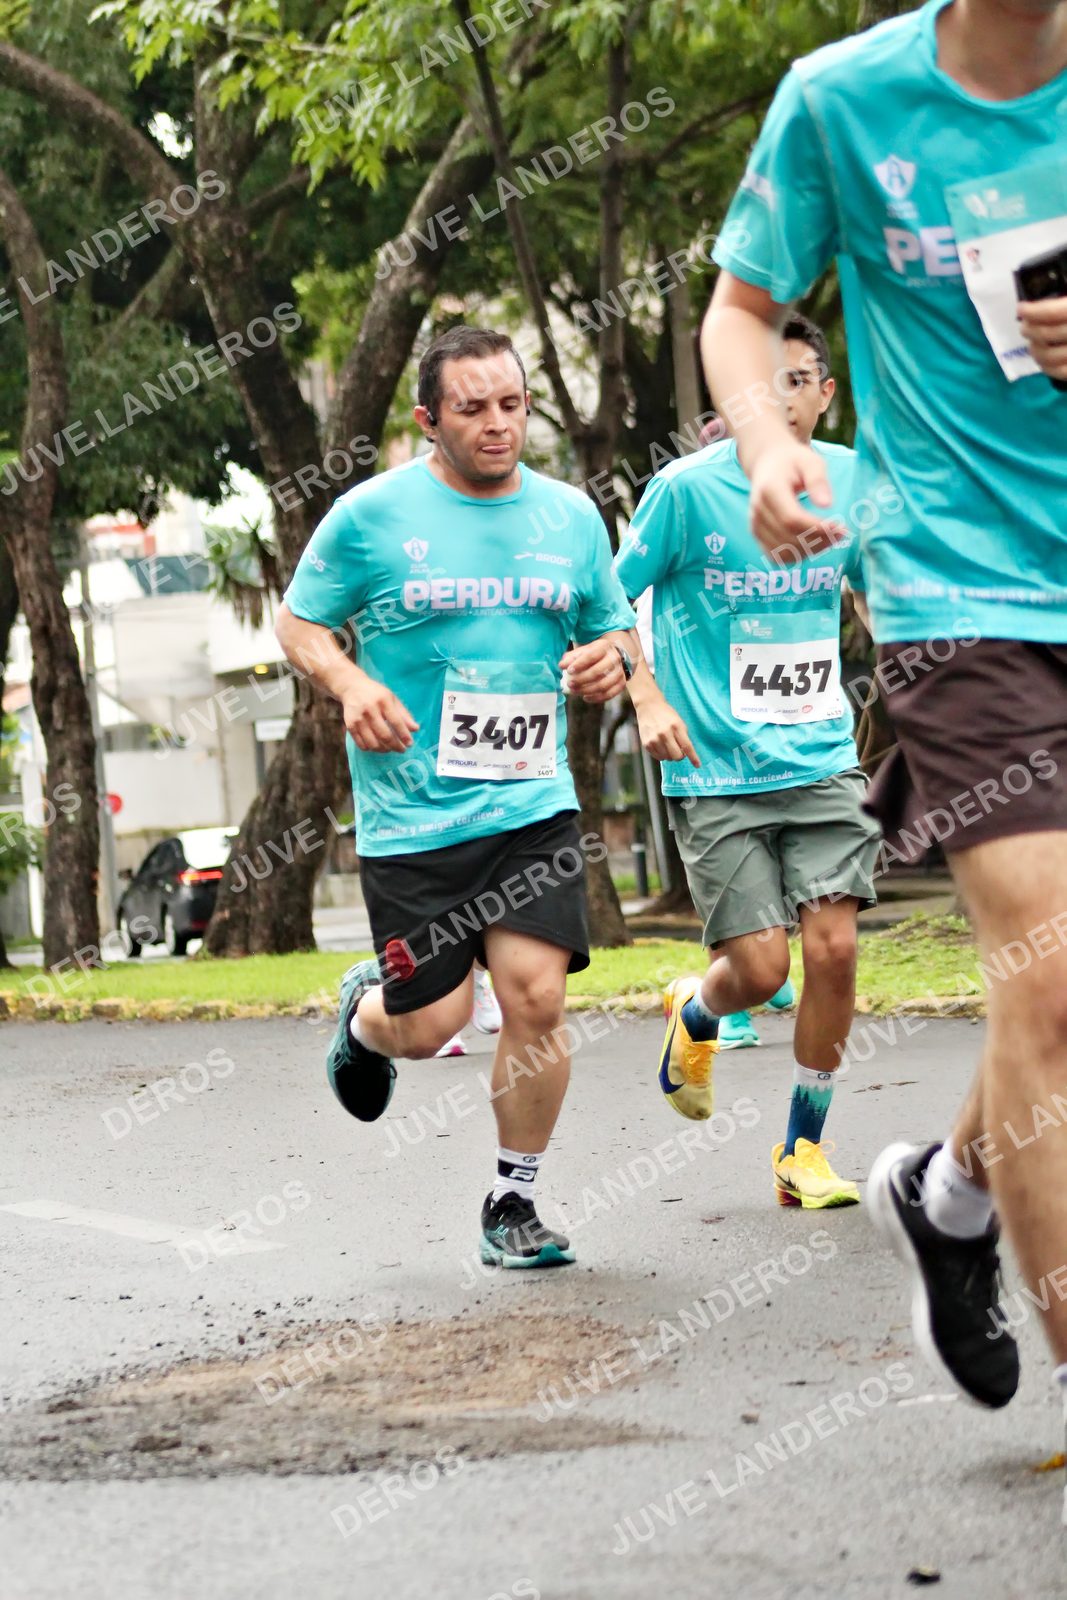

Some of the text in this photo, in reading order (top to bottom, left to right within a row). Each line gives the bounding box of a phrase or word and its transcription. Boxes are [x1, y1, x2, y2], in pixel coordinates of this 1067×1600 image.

[535, 553, 573, 568] BROOKS
[403, 577, 571, 613] PERDURA
[703, 563, 844, 597] PERDURA
[741, 660, 832, 696] 4437
[450, 714, 549, 750] 3407
[749, 770, 793, 785] corriendo
